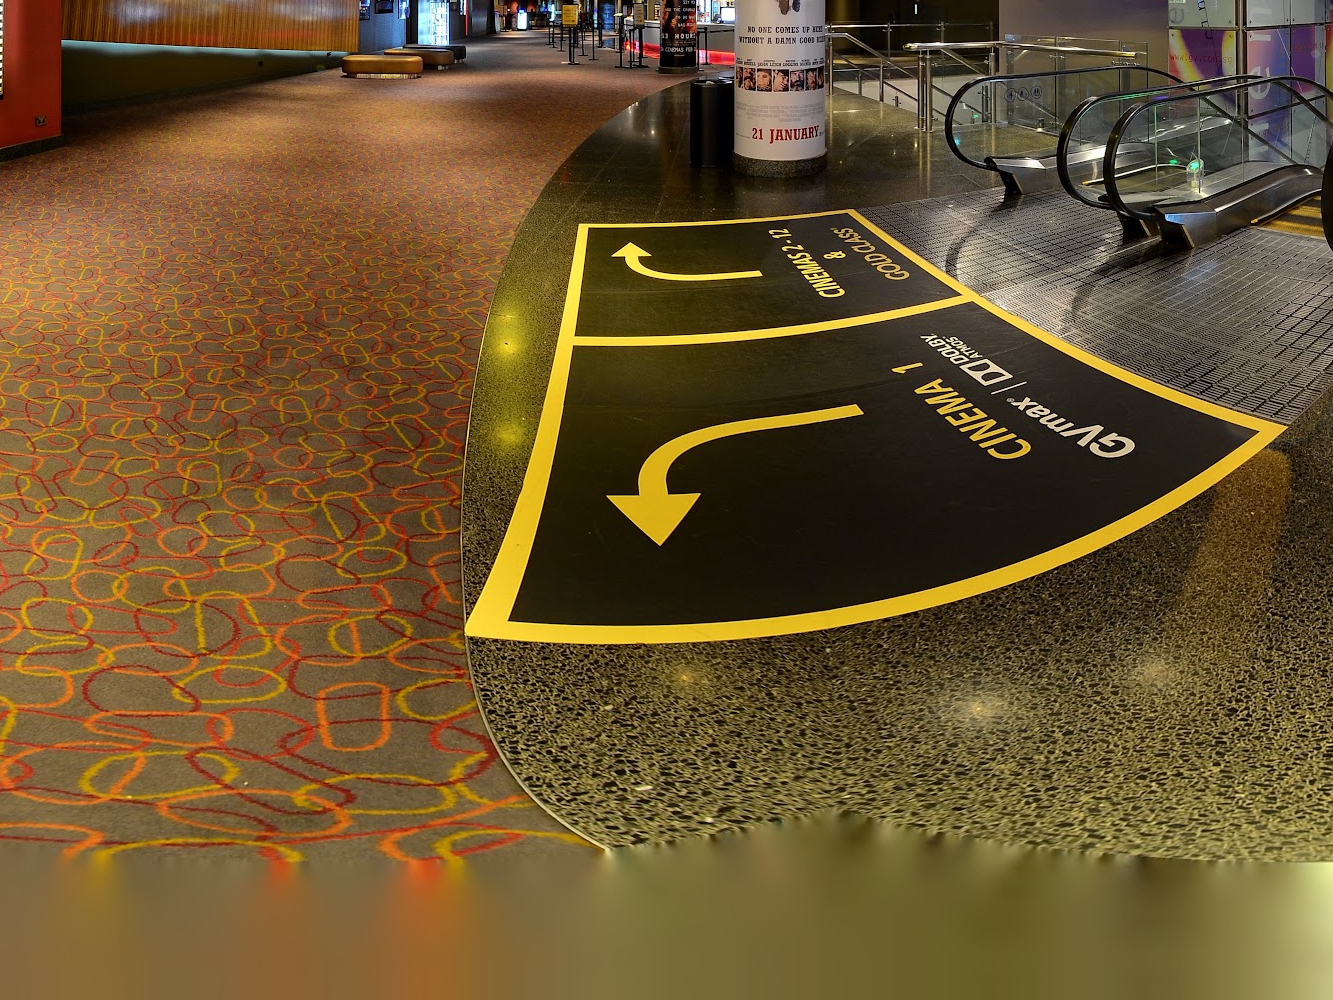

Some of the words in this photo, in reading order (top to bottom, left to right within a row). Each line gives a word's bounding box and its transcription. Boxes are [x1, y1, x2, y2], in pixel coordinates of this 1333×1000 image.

[775, 26, 799, 34] COMES
[739, 36, 765, 44] WITHOUT
[775, 36, 797, 44] DAMN
[799, 36, 815, 44] GOOD
[752, 128, 763, 140] 21
[769, 125, 820, 144] JANUARY
[769, 228, 792, 240] 12
[781, 244, 804, 252] 2
[823, 250, 847, 260] &
[865, 253, 910, 280] GOLD
[787, 252, 845, 298] CINEMAS
[920, 333, 970, 365] DOLBY
[944, 336, 983, 358] ATMOS
[891, 362, 924, 374] 1
[913, 378, 1031, 460] CINEMA
